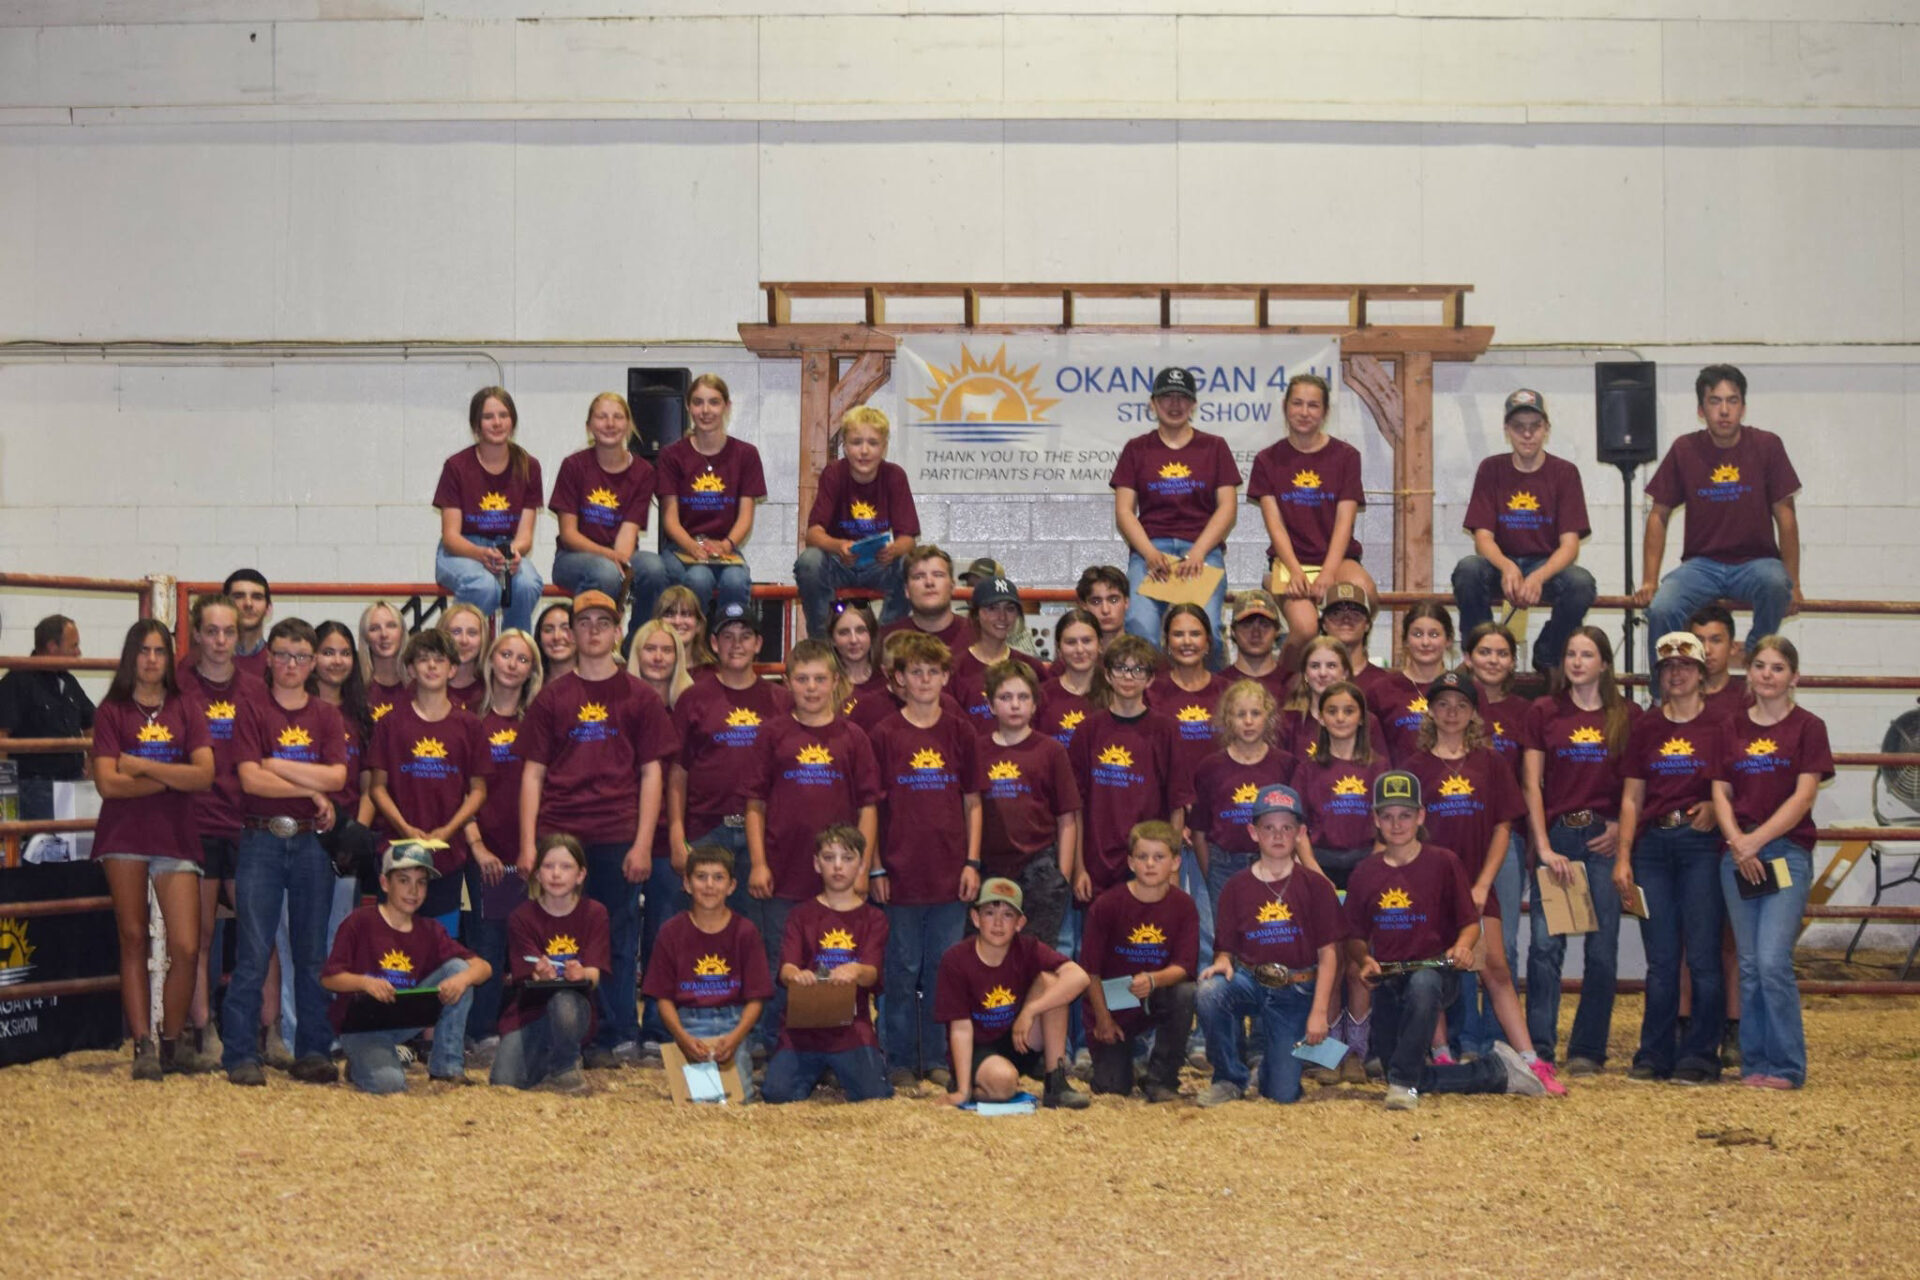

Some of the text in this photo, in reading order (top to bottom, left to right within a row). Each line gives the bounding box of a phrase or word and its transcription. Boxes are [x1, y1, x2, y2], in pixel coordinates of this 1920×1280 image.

[1056, 366, 1256, 393] OKANGAN
[1200, 402, 1272, 422] SHOW
[926, 450, 1122, 463] THANK YOU TO THE SPON
[920, 468, 1029, 481] PARTICIPANTS
[1033, 468, 1066, 481] FOR
